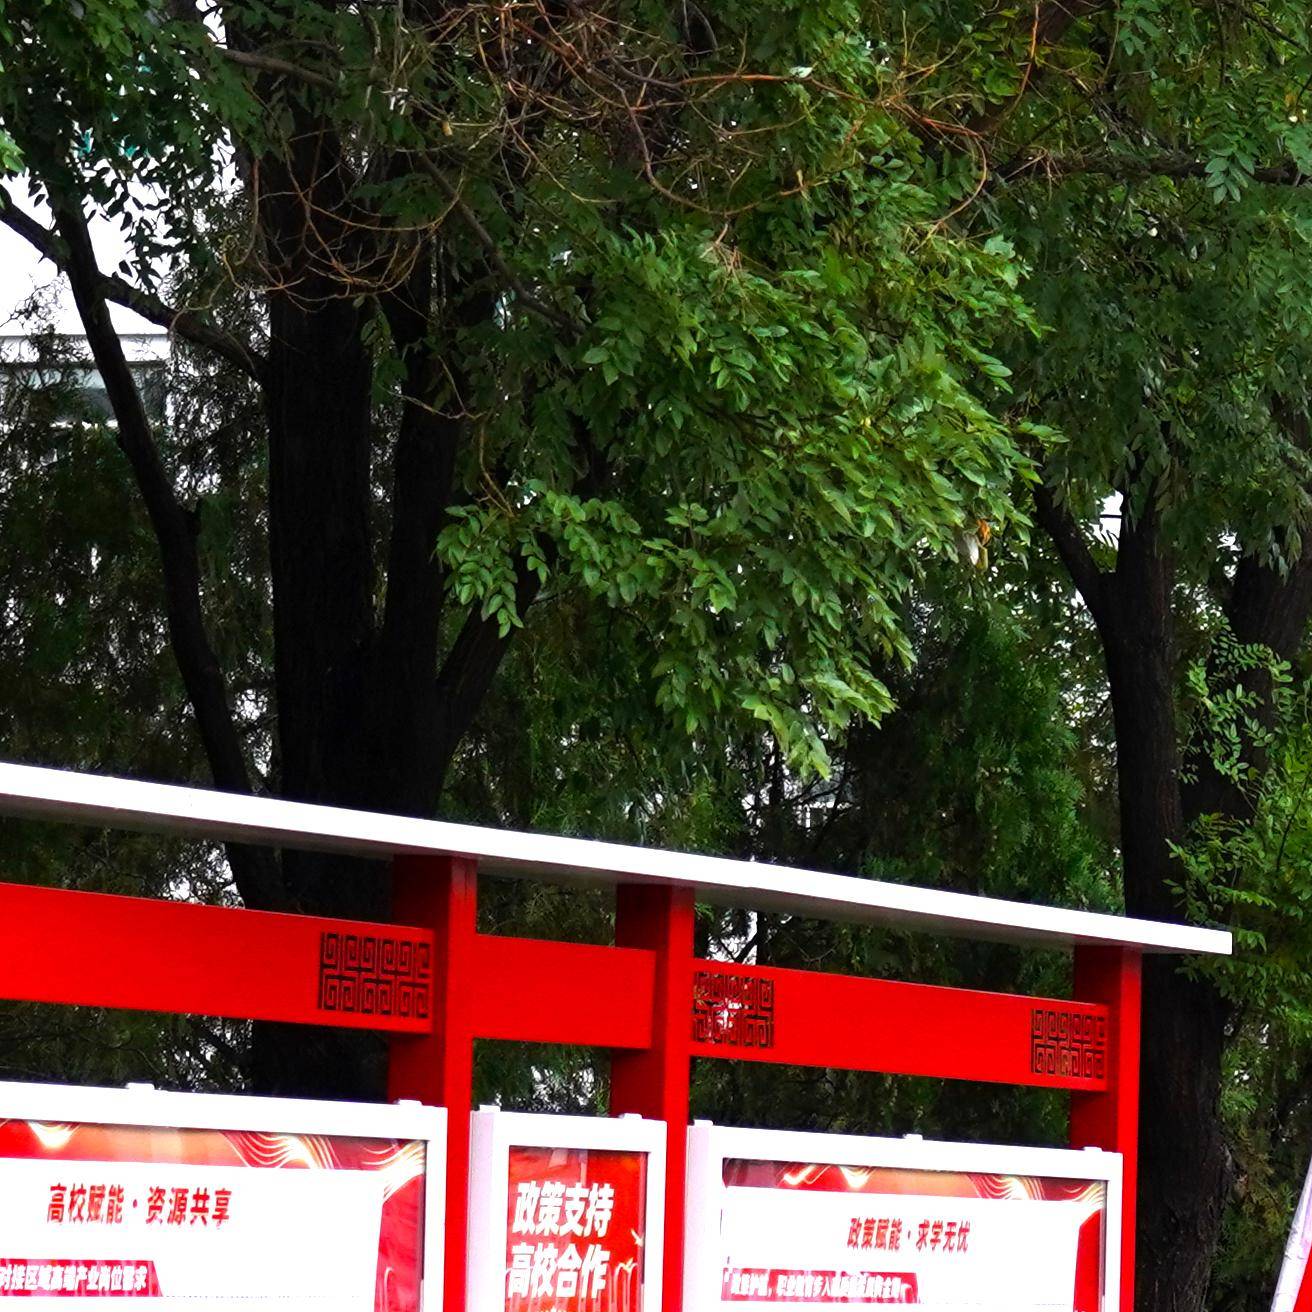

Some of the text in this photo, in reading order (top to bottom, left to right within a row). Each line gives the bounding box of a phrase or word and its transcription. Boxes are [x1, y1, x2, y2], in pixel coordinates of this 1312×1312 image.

[512, 1180, 615, 1237] 政策支持
[508, 1242, 610, 1299] 高校合作
